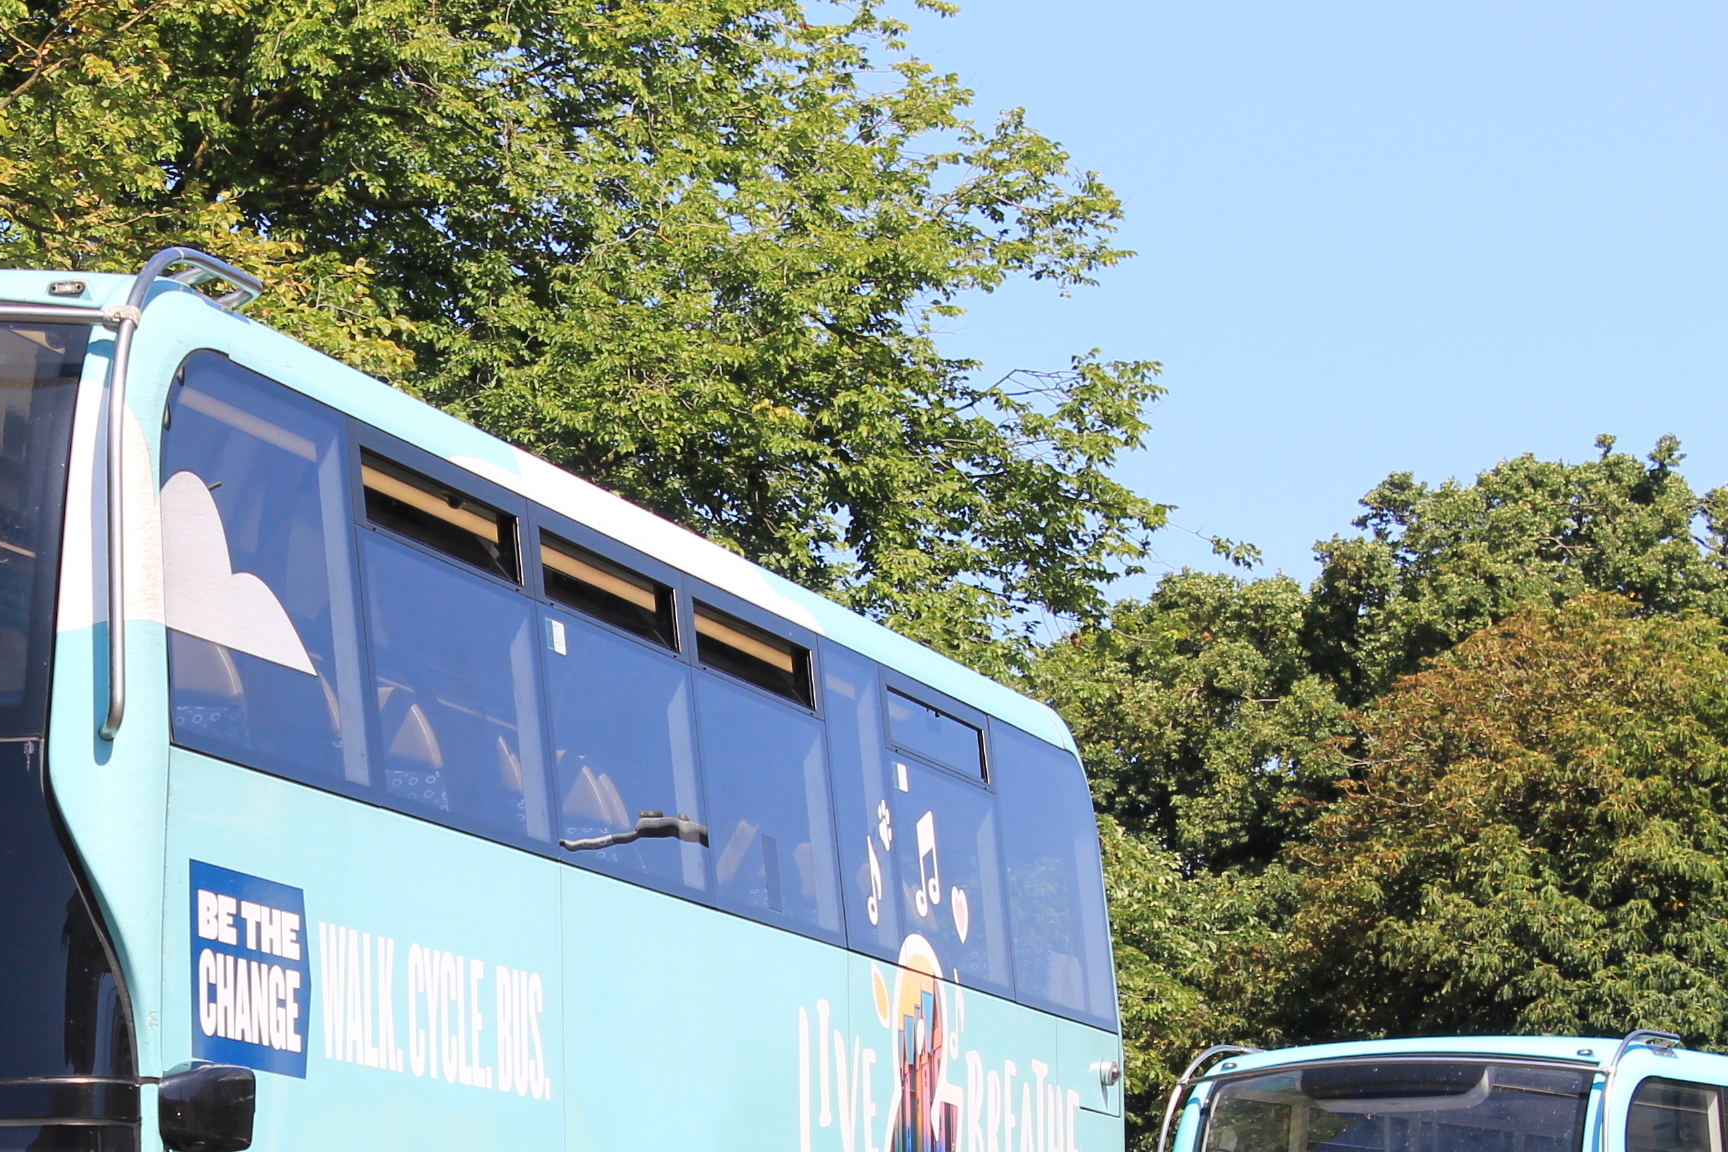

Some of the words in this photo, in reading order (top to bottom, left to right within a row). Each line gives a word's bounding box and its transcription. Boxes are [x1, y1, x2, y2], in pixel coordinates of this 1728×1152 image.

[197, 888, 237, 946] BE
[240, 900, 301, 961] THE
[198, 948, 302, 1054] CHANGE
[318, 921, 404, 1073] WALK.
[408, 943, 493, 1090] CYCLE.
[496, 965, 552, 1101] BUS.
